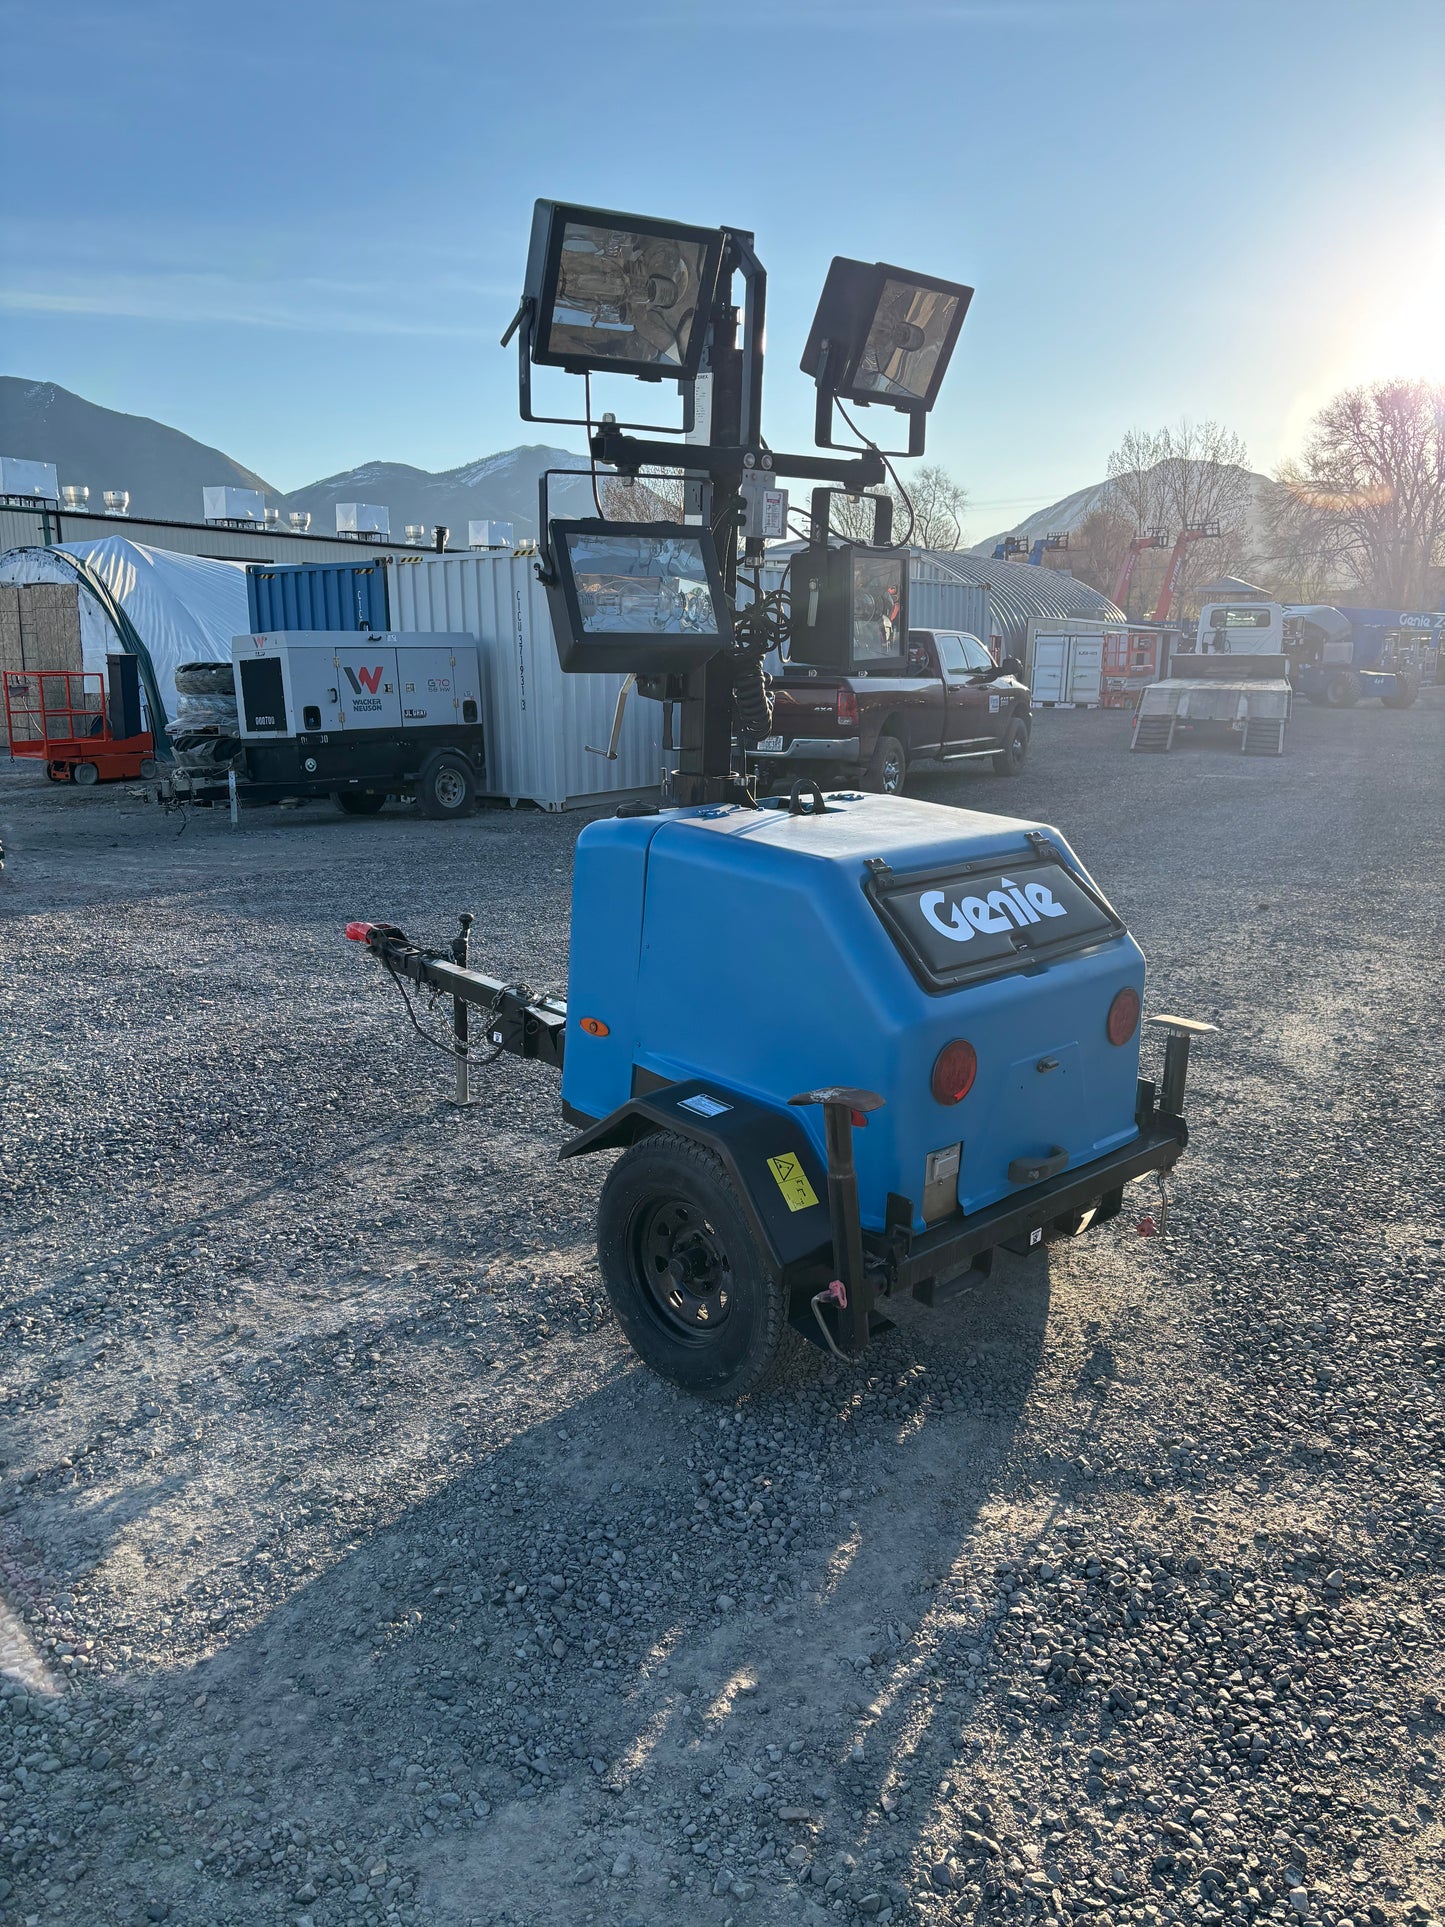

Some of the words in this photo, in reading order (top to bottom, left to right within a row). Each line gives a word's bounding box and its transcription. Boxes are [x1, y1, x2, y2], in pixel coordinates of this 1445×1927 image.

[1399, 613, 1431, 627] Genie
[428, 678, 450, 687] G70
[353, 704, 382, 712] NEUSON
[919, 876, 1067, 942] Genie
